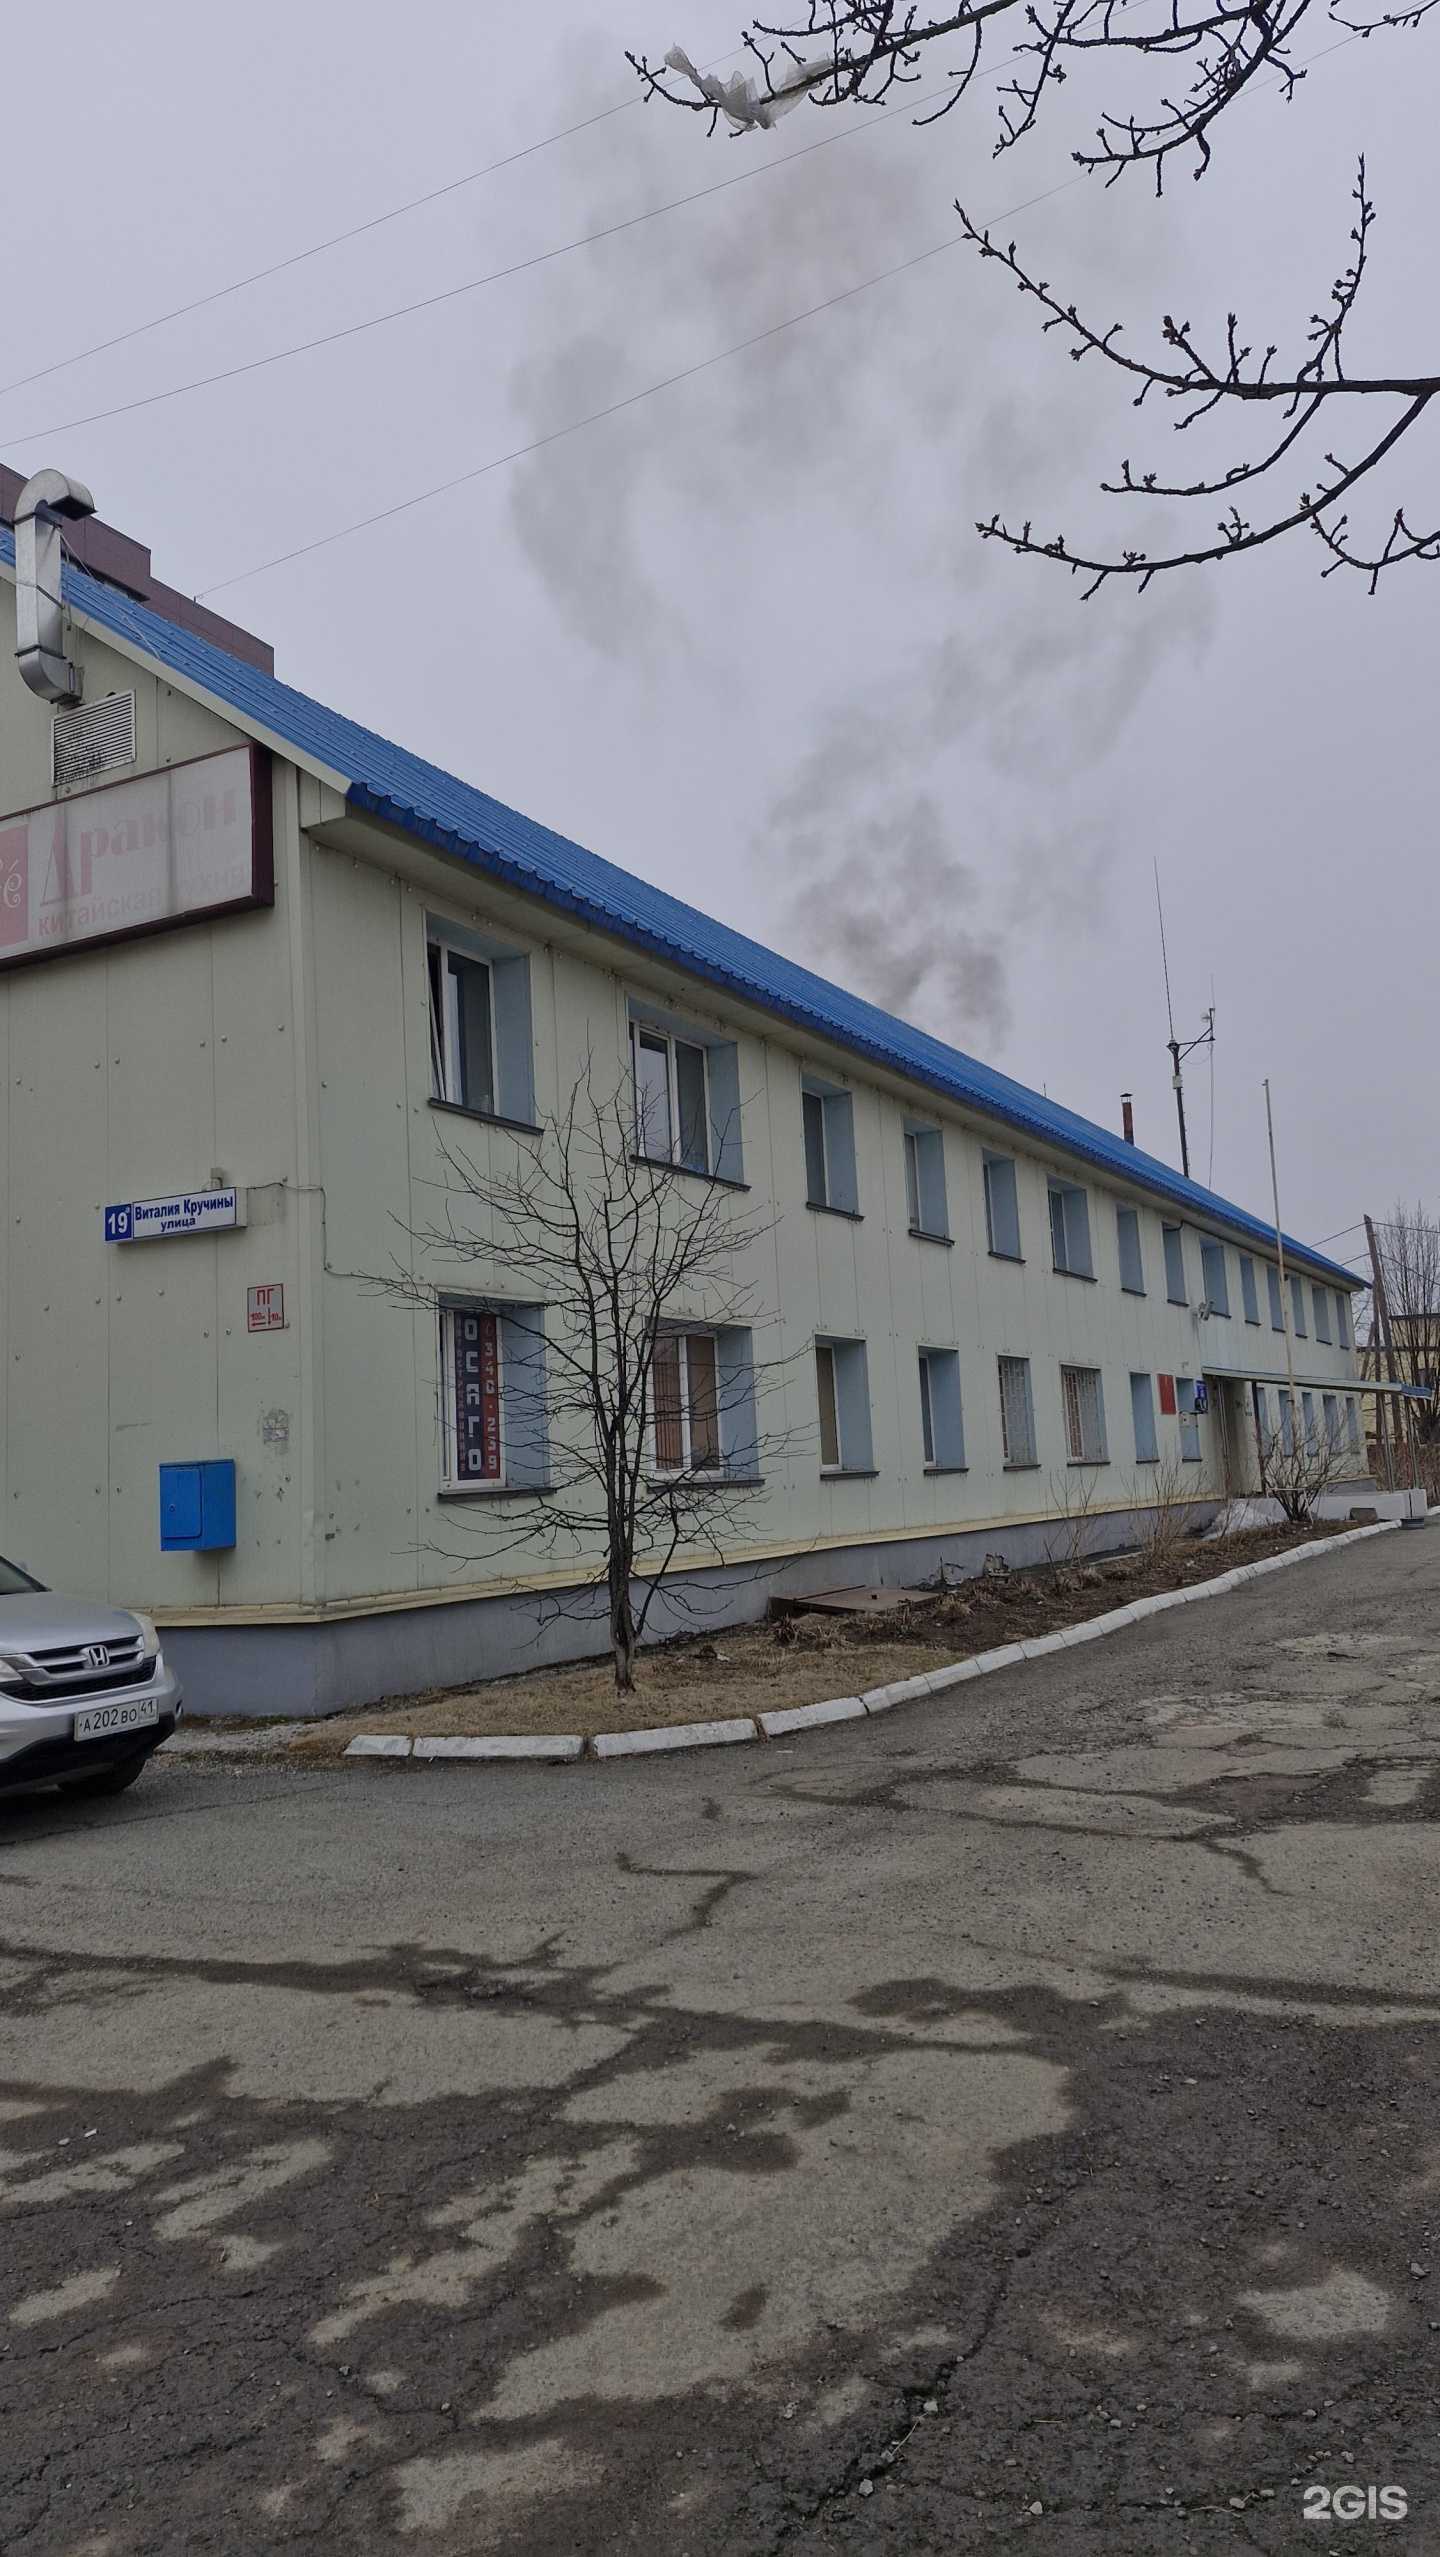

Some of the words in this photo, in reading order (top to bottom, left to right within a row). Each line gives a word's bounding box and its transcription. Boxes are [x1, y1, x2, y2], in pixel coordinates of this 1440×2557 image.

[135, 1203, 180, 1221] Виталия
[183, 1196, 234, 1216] Кручины
[108, 1212, 128, 1235] 19
[160, 1216, 196, 1233] улица
[256, 1288, 274, 1306] ПГ
[464, 1319, 482, 1472] ОСАГО
